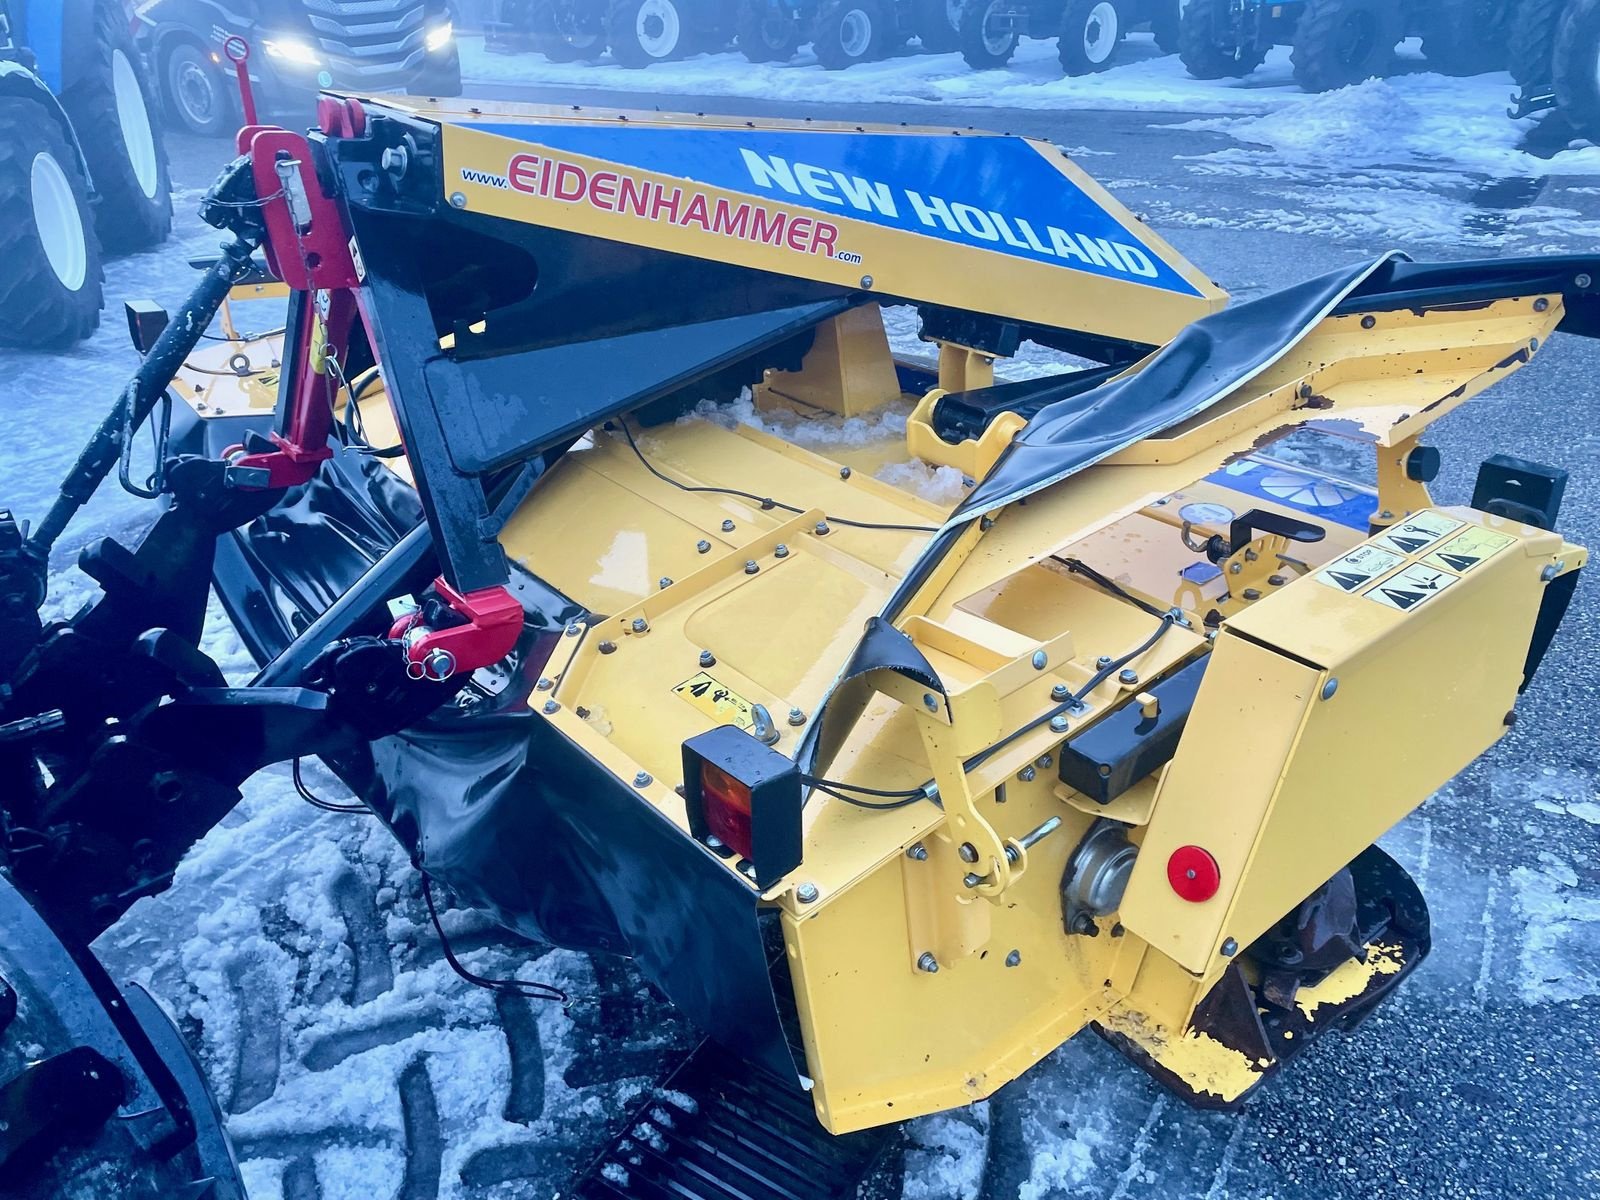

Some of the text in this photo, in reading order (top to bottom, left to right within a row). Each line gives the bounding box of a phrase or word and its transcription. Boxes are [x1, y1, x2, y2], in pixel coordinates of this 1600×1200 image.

[462, 154, 862, 264] www.EIDENHAMMER.com
[739, 148, 1160, 279] NEW HOLLAND
